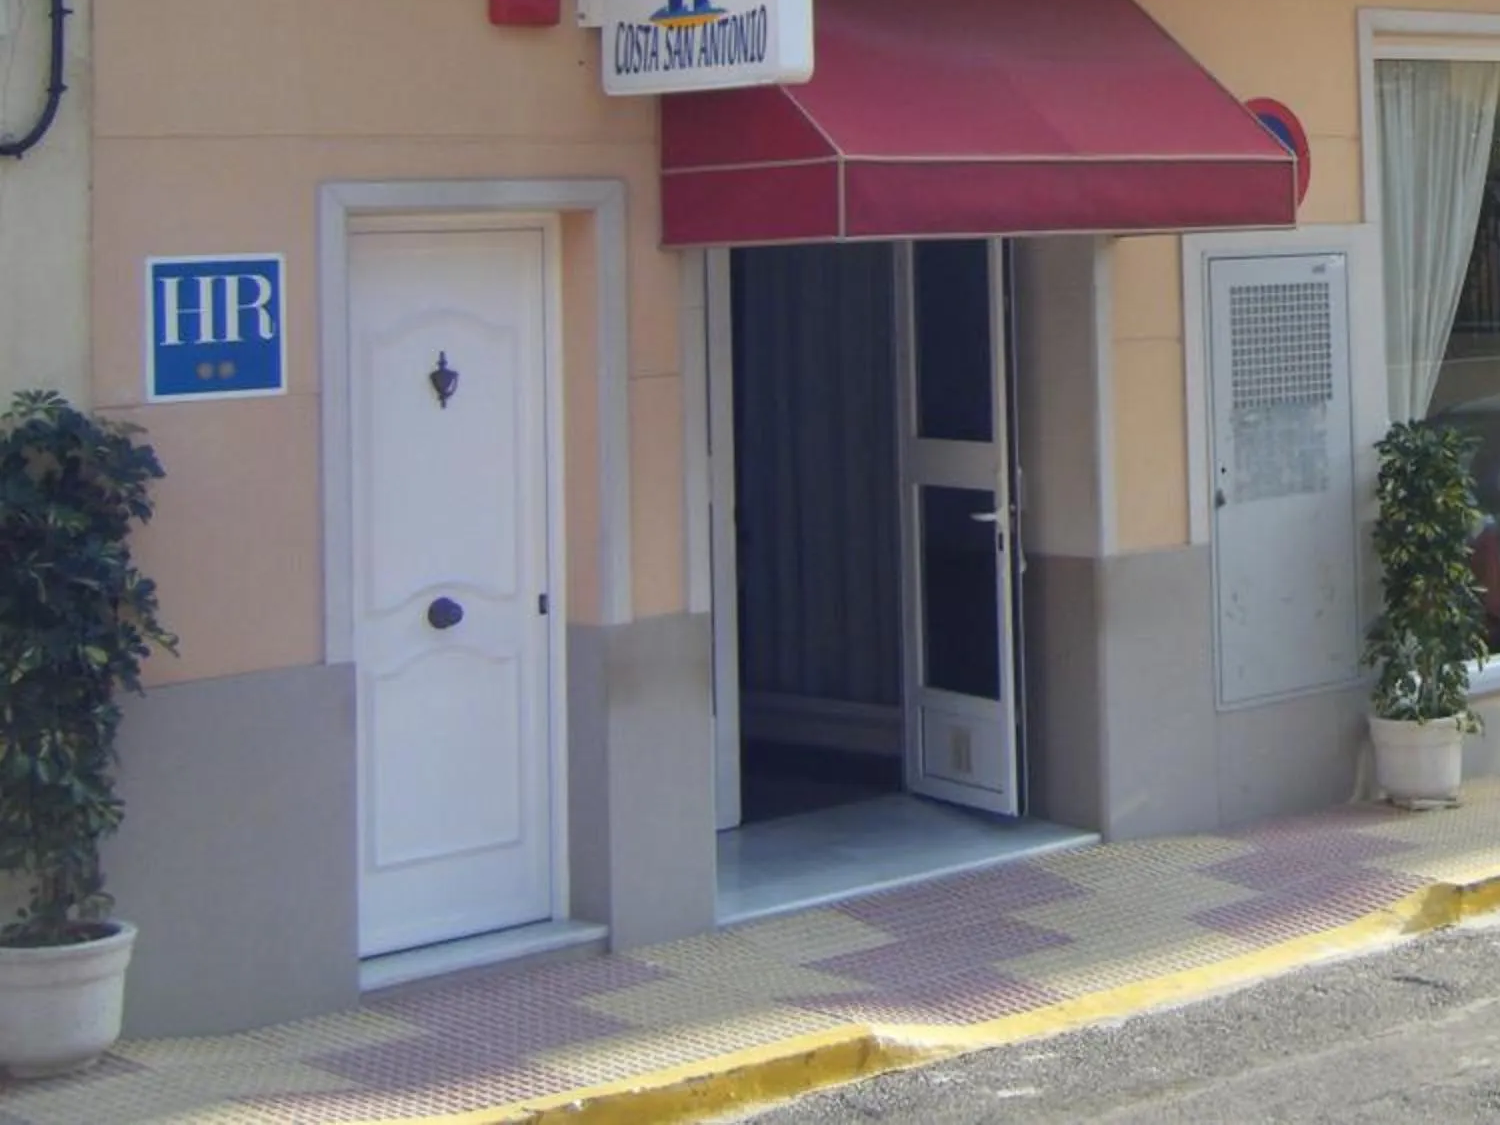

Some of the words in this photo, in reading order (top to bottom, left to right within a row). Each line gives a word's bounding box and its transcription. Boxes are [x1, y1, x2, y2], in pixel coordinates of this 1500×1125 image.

[614, 21, 659, 74] COSTA
[663, 23, 695, 71] SAN
[697, 4, 768, 68] ANTONIO
[158, 274, 273, 346] HR
